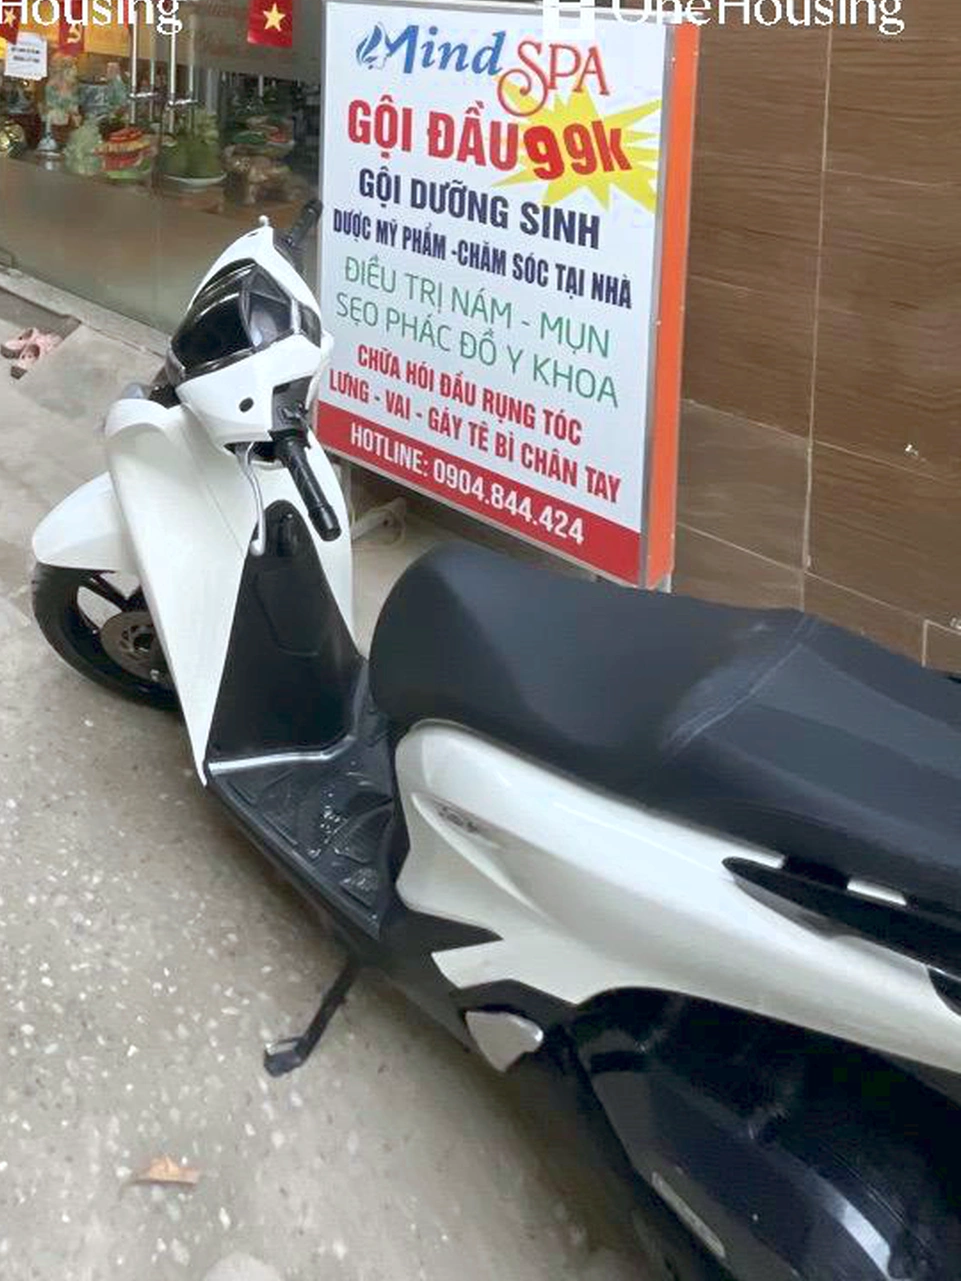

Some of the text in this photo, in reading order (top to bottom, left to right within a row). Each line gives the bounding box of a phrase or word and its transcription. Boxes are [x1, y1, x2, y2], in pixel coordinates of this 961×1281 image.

[382, 23, 610, 117] Mind SPA
[348, 94, 413, 160] GỘI
[427, 100, 519, 172] ĐẦU
[333, 208, 371, 242] DƯỢC
[376, 218, 398, 248] MỸ
[402, 222, 447, 261] PHẨM
[512, 249, 549, 288] SÓC
[555, 263, 585, 300] TẠI
[592, 272, 632, 310] NHÀ
[359, 167, 601, 251] GỘI DƯỠNG SINH
[336, 292, 619, 408] SẸO PHÁC ĐỒ Y KHOA
[344, 254, 397, 294] ĐIỀU
[405, 273, 443, 315] TRỊ
[451, 287, 512, 329] NÁM
[540, 311, 610, 359] MỤN
[329, 369, 370, 404] LƯNG
[385, 389, 411, 421] VAI
[468, 419, 488, 453] TÊ
[495, 432, 515, 463] BÌ
[521, 440, 578, 488] CHÂN
[585, 465, 622, 505] TAY
[357, 343, 583, 446] CHỮA HÓI ĐẦU RỤNG TÓC
[351, 422, 585, 545] HOTLINE: 0904.844.424
